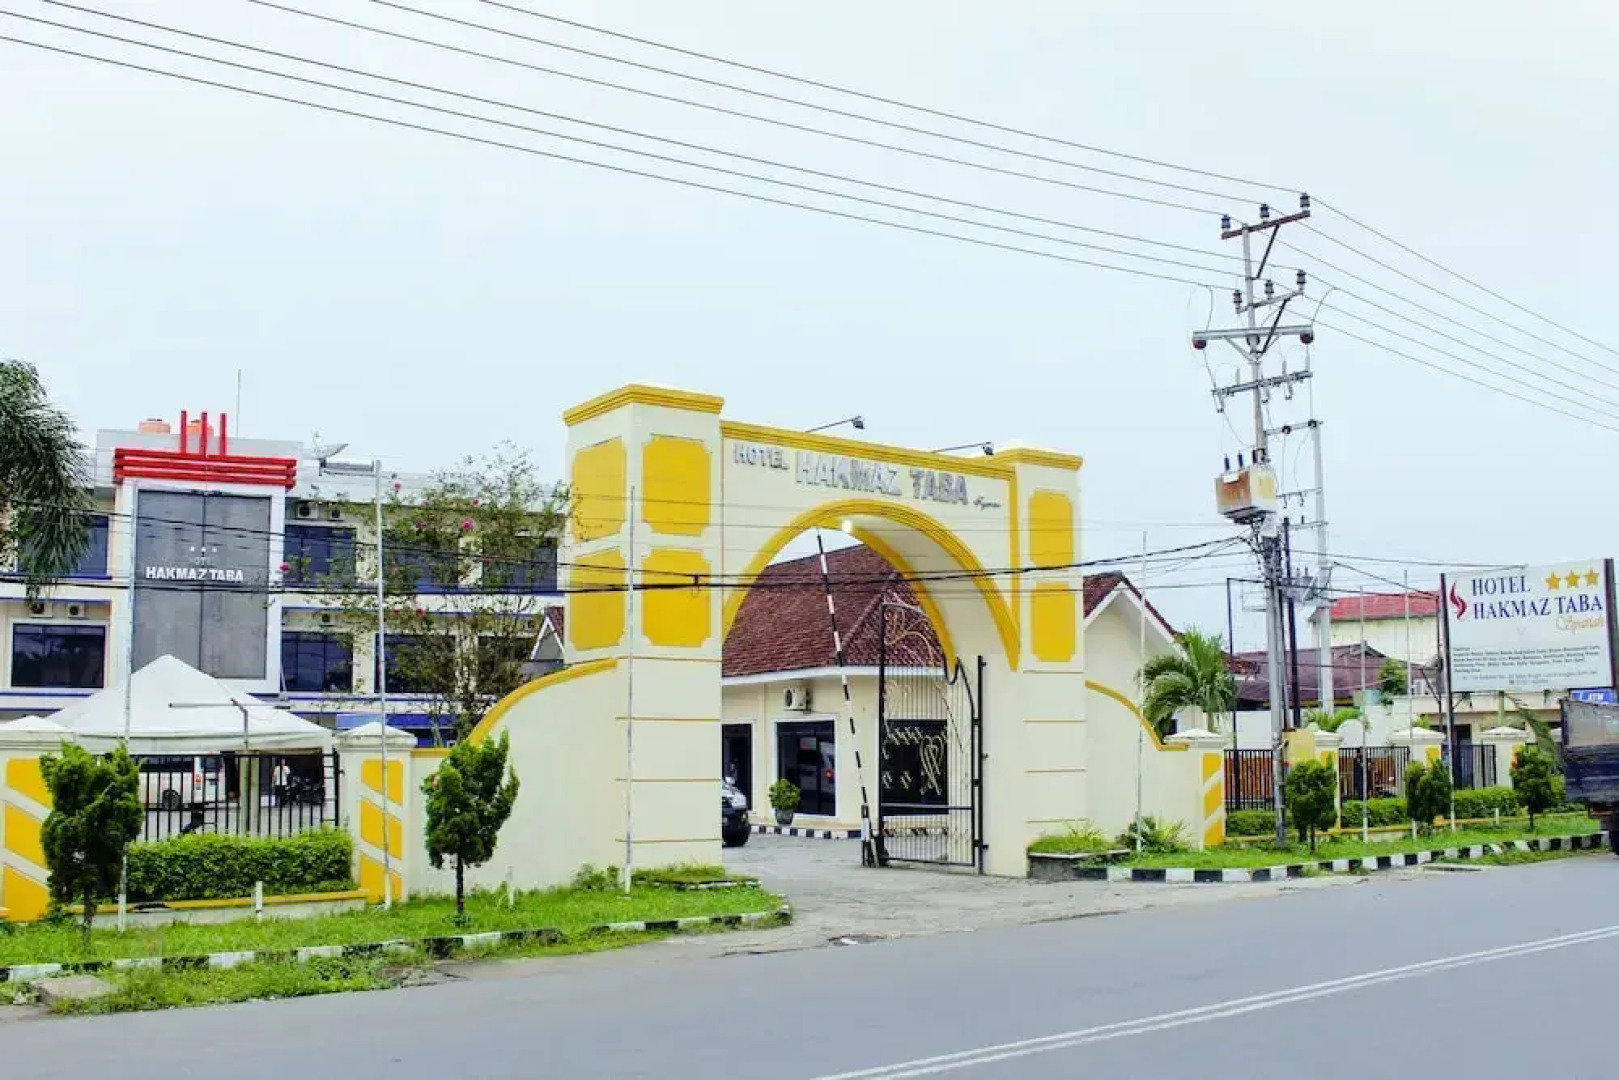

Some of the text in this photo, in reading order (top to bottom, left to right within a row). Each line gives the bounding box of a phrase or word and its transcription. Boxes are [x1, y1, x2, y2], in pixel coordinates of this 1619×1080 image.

[733, 442, 790, 470] HOTEL
[795, 451, 901, 496] HAKMAZ
[909, 467, 969, 505] TABA
[145, 566, 244, 582] HAKMAZ TABA
[1472, 575, 1531, 597] HOTEL
[1474, 593, 1604, 620] HAKMAZ TABA
